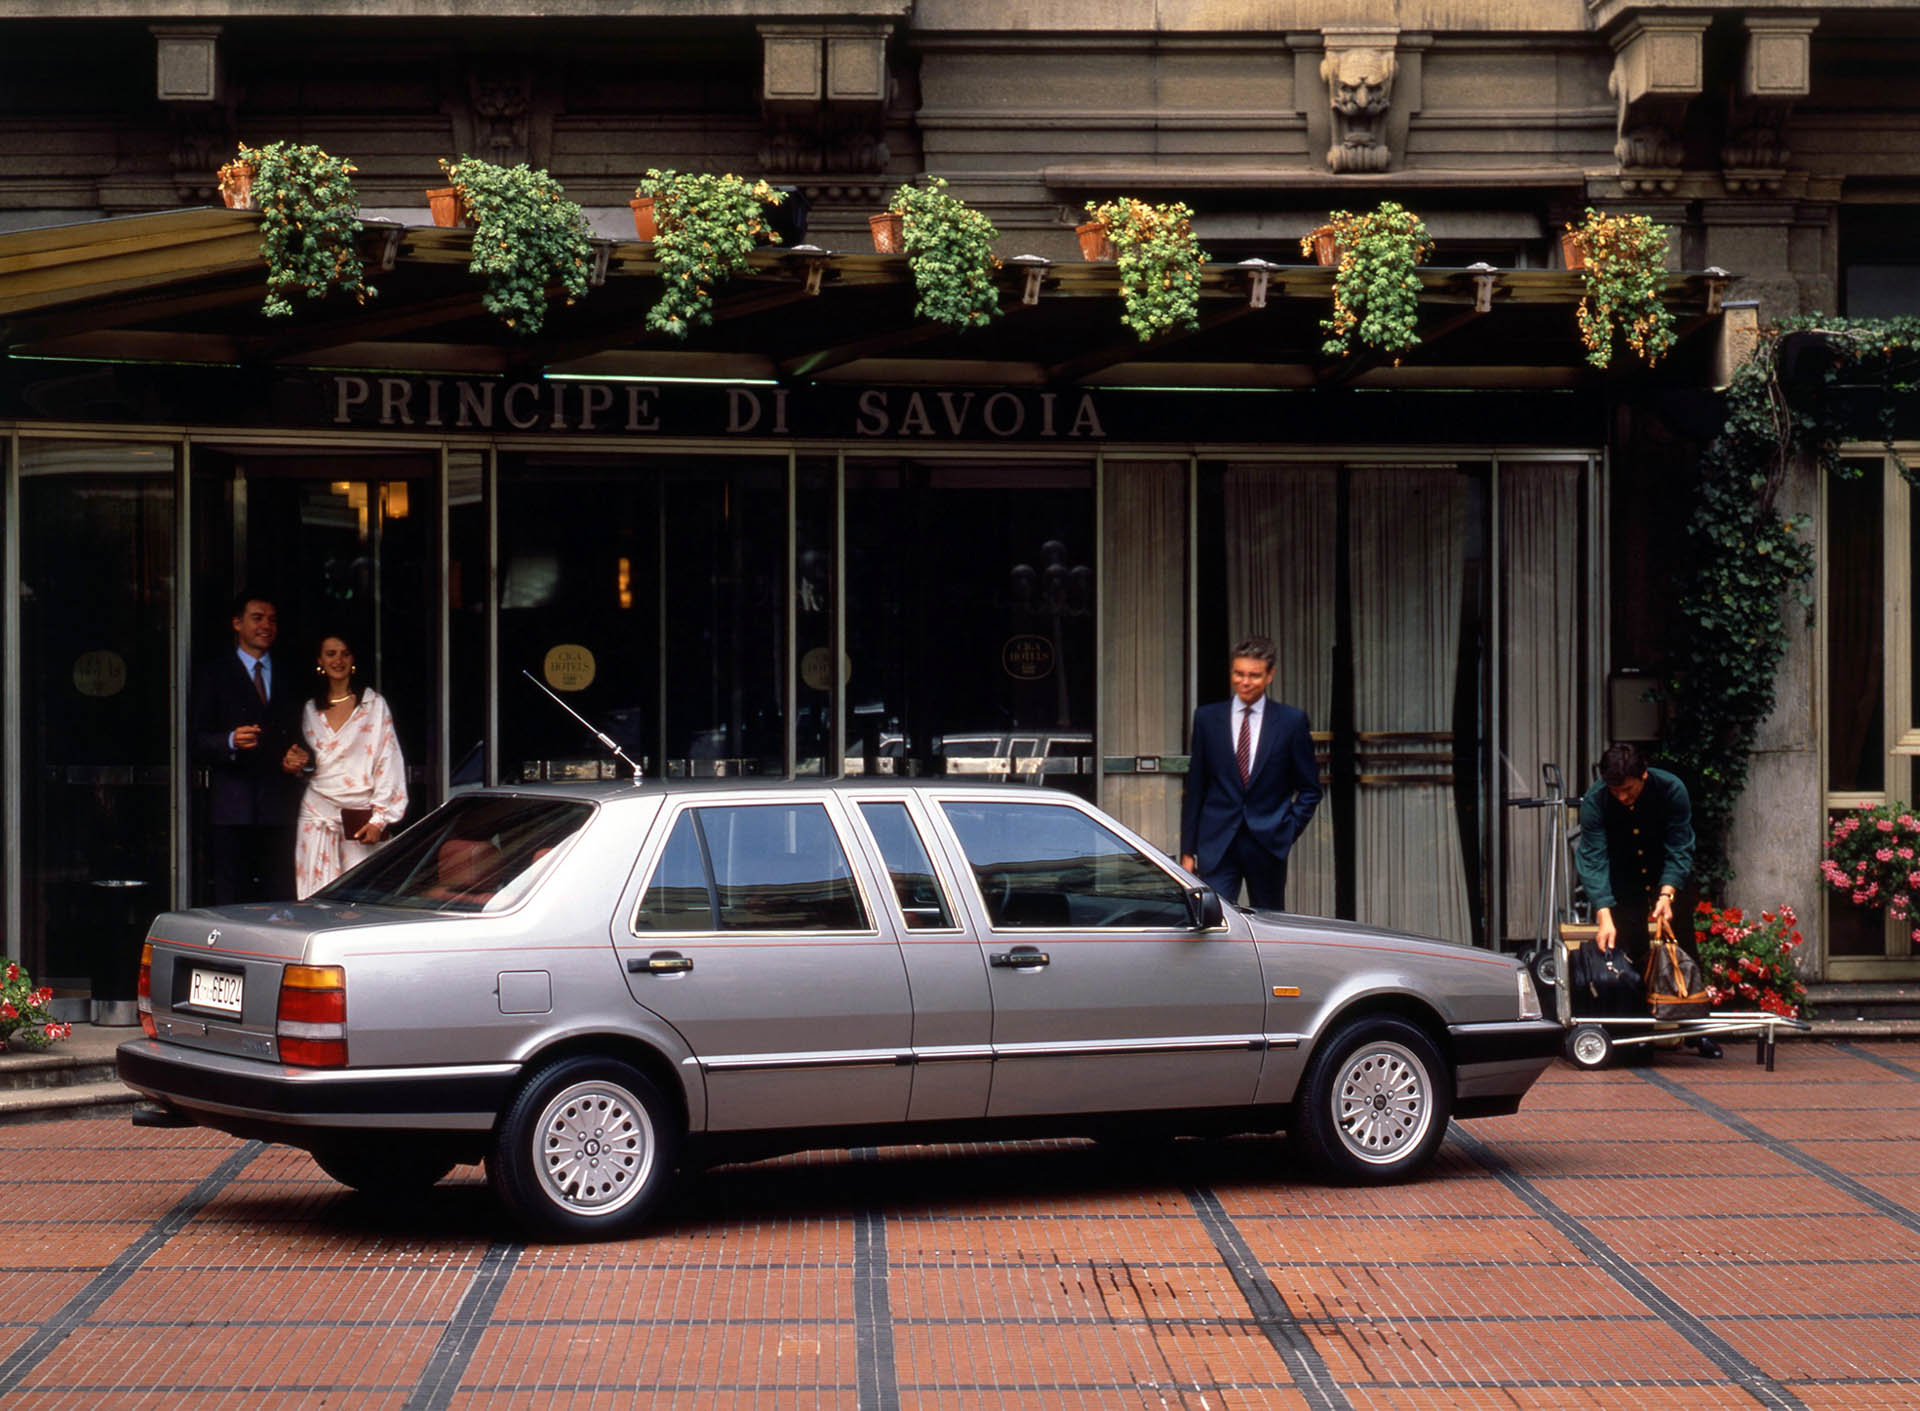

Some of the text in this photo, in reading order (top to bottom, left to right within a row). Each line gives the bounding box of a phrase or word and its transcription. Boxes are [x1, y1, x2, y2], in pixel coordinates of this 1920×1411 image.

[333, 376, 1107, 438] PRINCIPE DI SAVOIA
[550, 662, 590, 673] HOTELS
